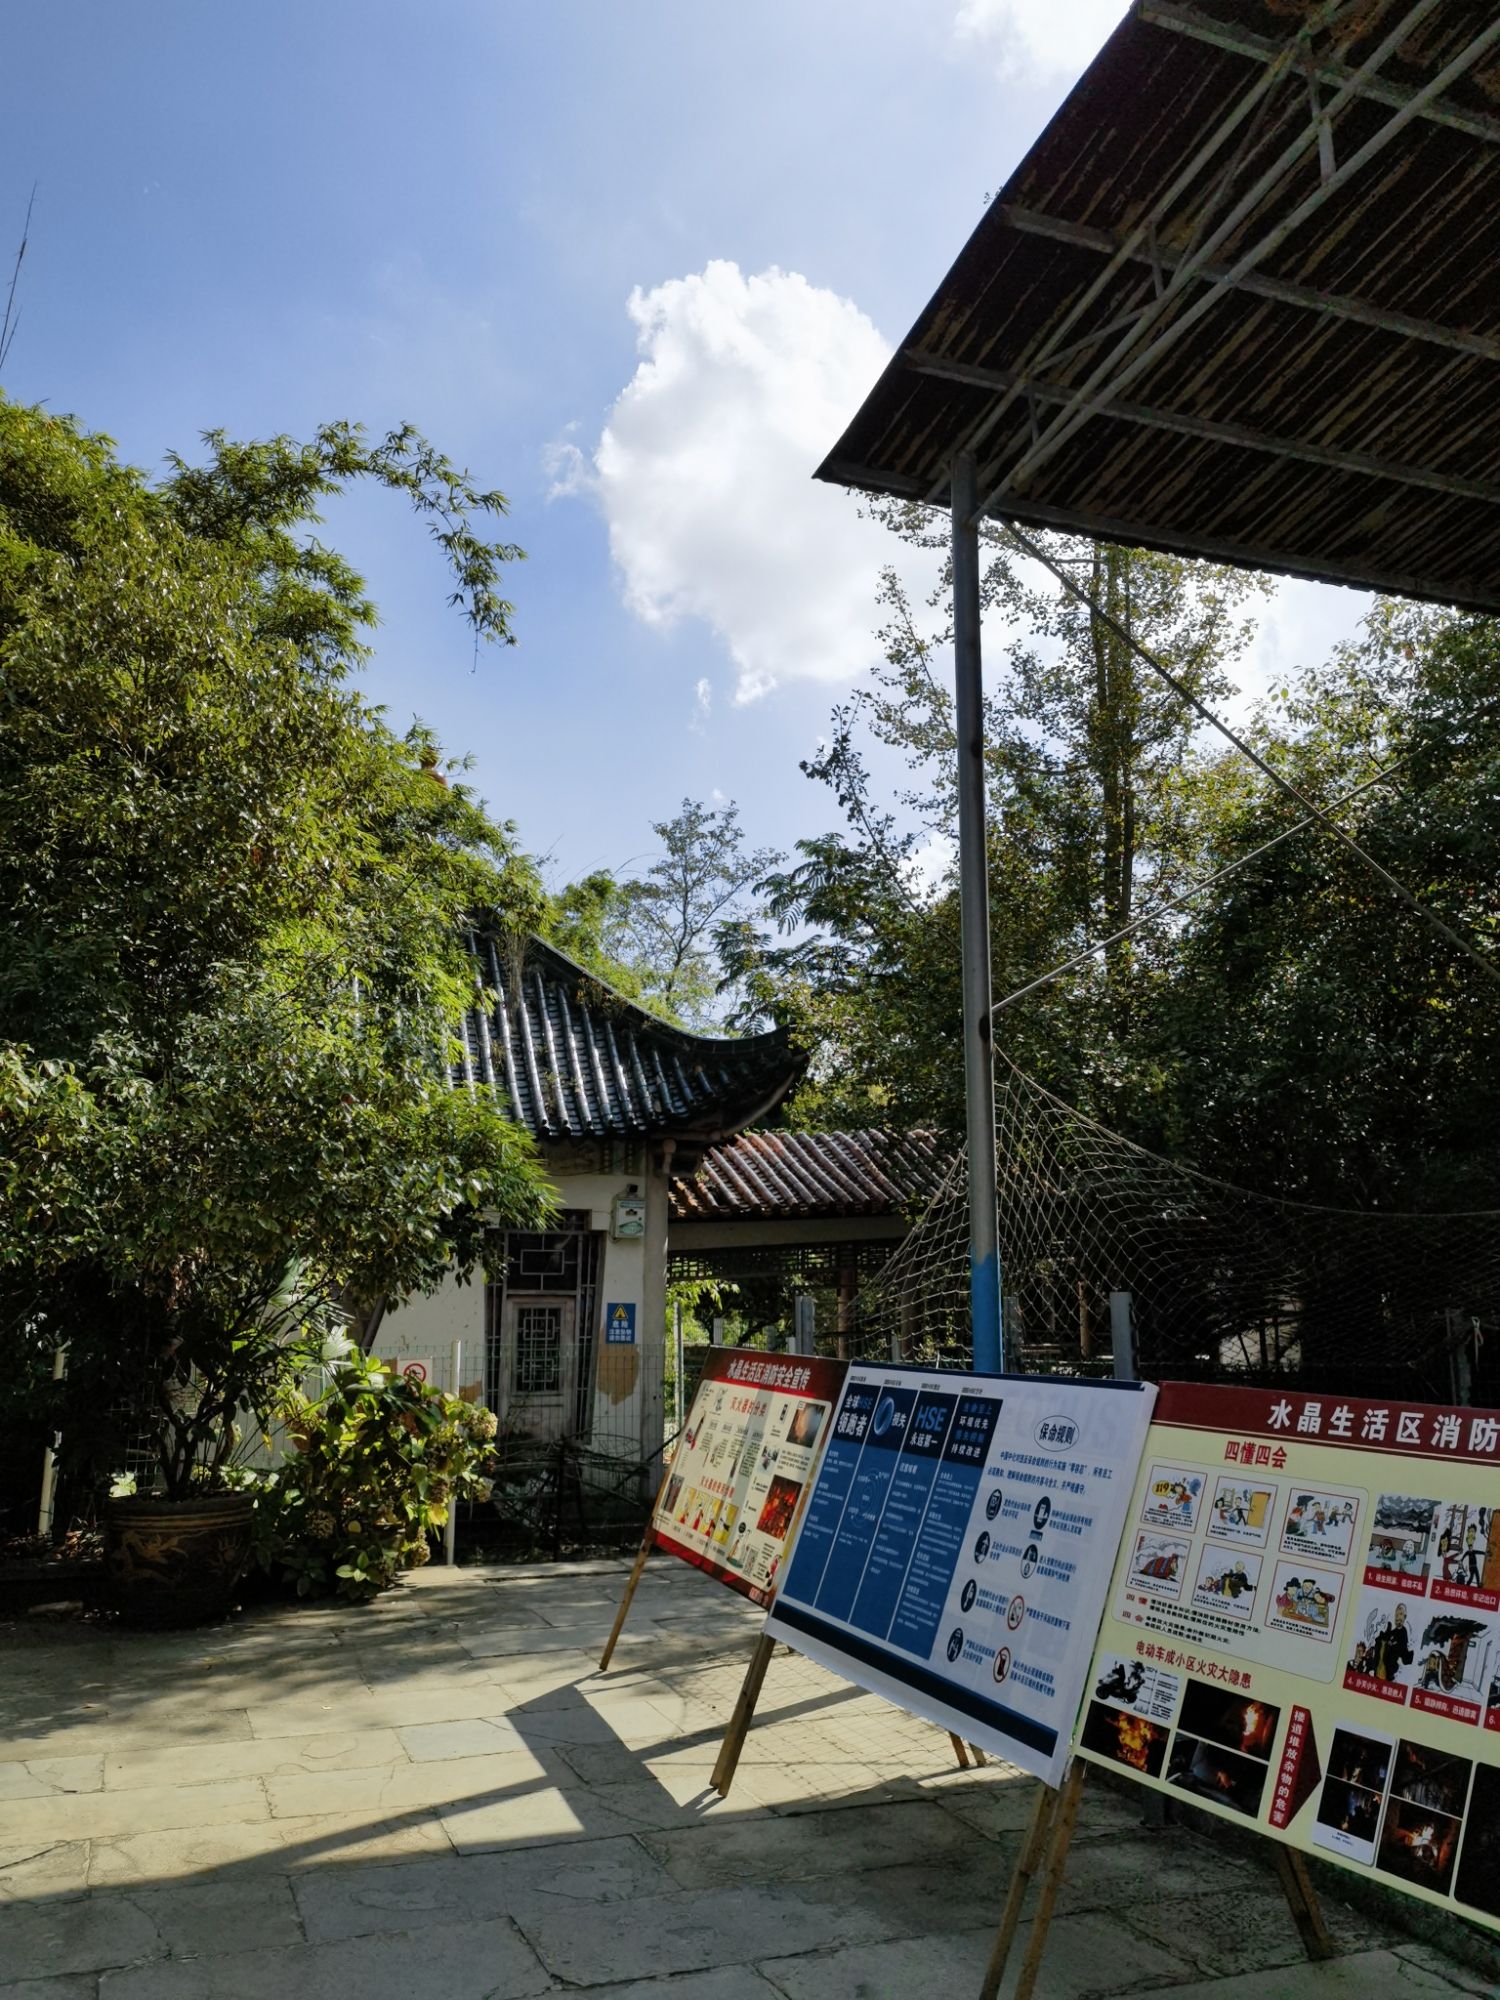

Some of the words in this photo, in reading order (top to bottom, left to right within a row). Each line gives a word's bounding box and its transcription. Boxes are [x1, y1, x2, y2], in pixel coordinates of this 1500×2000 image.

[727, 1359, 811, 1391] 水晶生活区消防安全宣传
[730, 1396, 768, 1417] 灭火器的分类
[915, 1405, 948, 1432] HSE
[837, 1411, 868, 1437] 领跑者
[959, 1415, 989, 1429] 环境优先
[1039, 1422, 1076, 1445] 保命规则
[1267, 1399, 1500, 1452] 水晶生活区消防
[909, 1432, 938, 1448] 永远第一
[951, 1443, 982, 1458] 持续改进
[1224, 1440, 1288, 1469] 四懂四会
[1155, 1482, 1170, 1493] 119
[1135, 1640, 1253, 1689] 电动车成小区火灾大隐患
[1272, 1710, 1306, 1824] 楼道堆放杂物的危害
